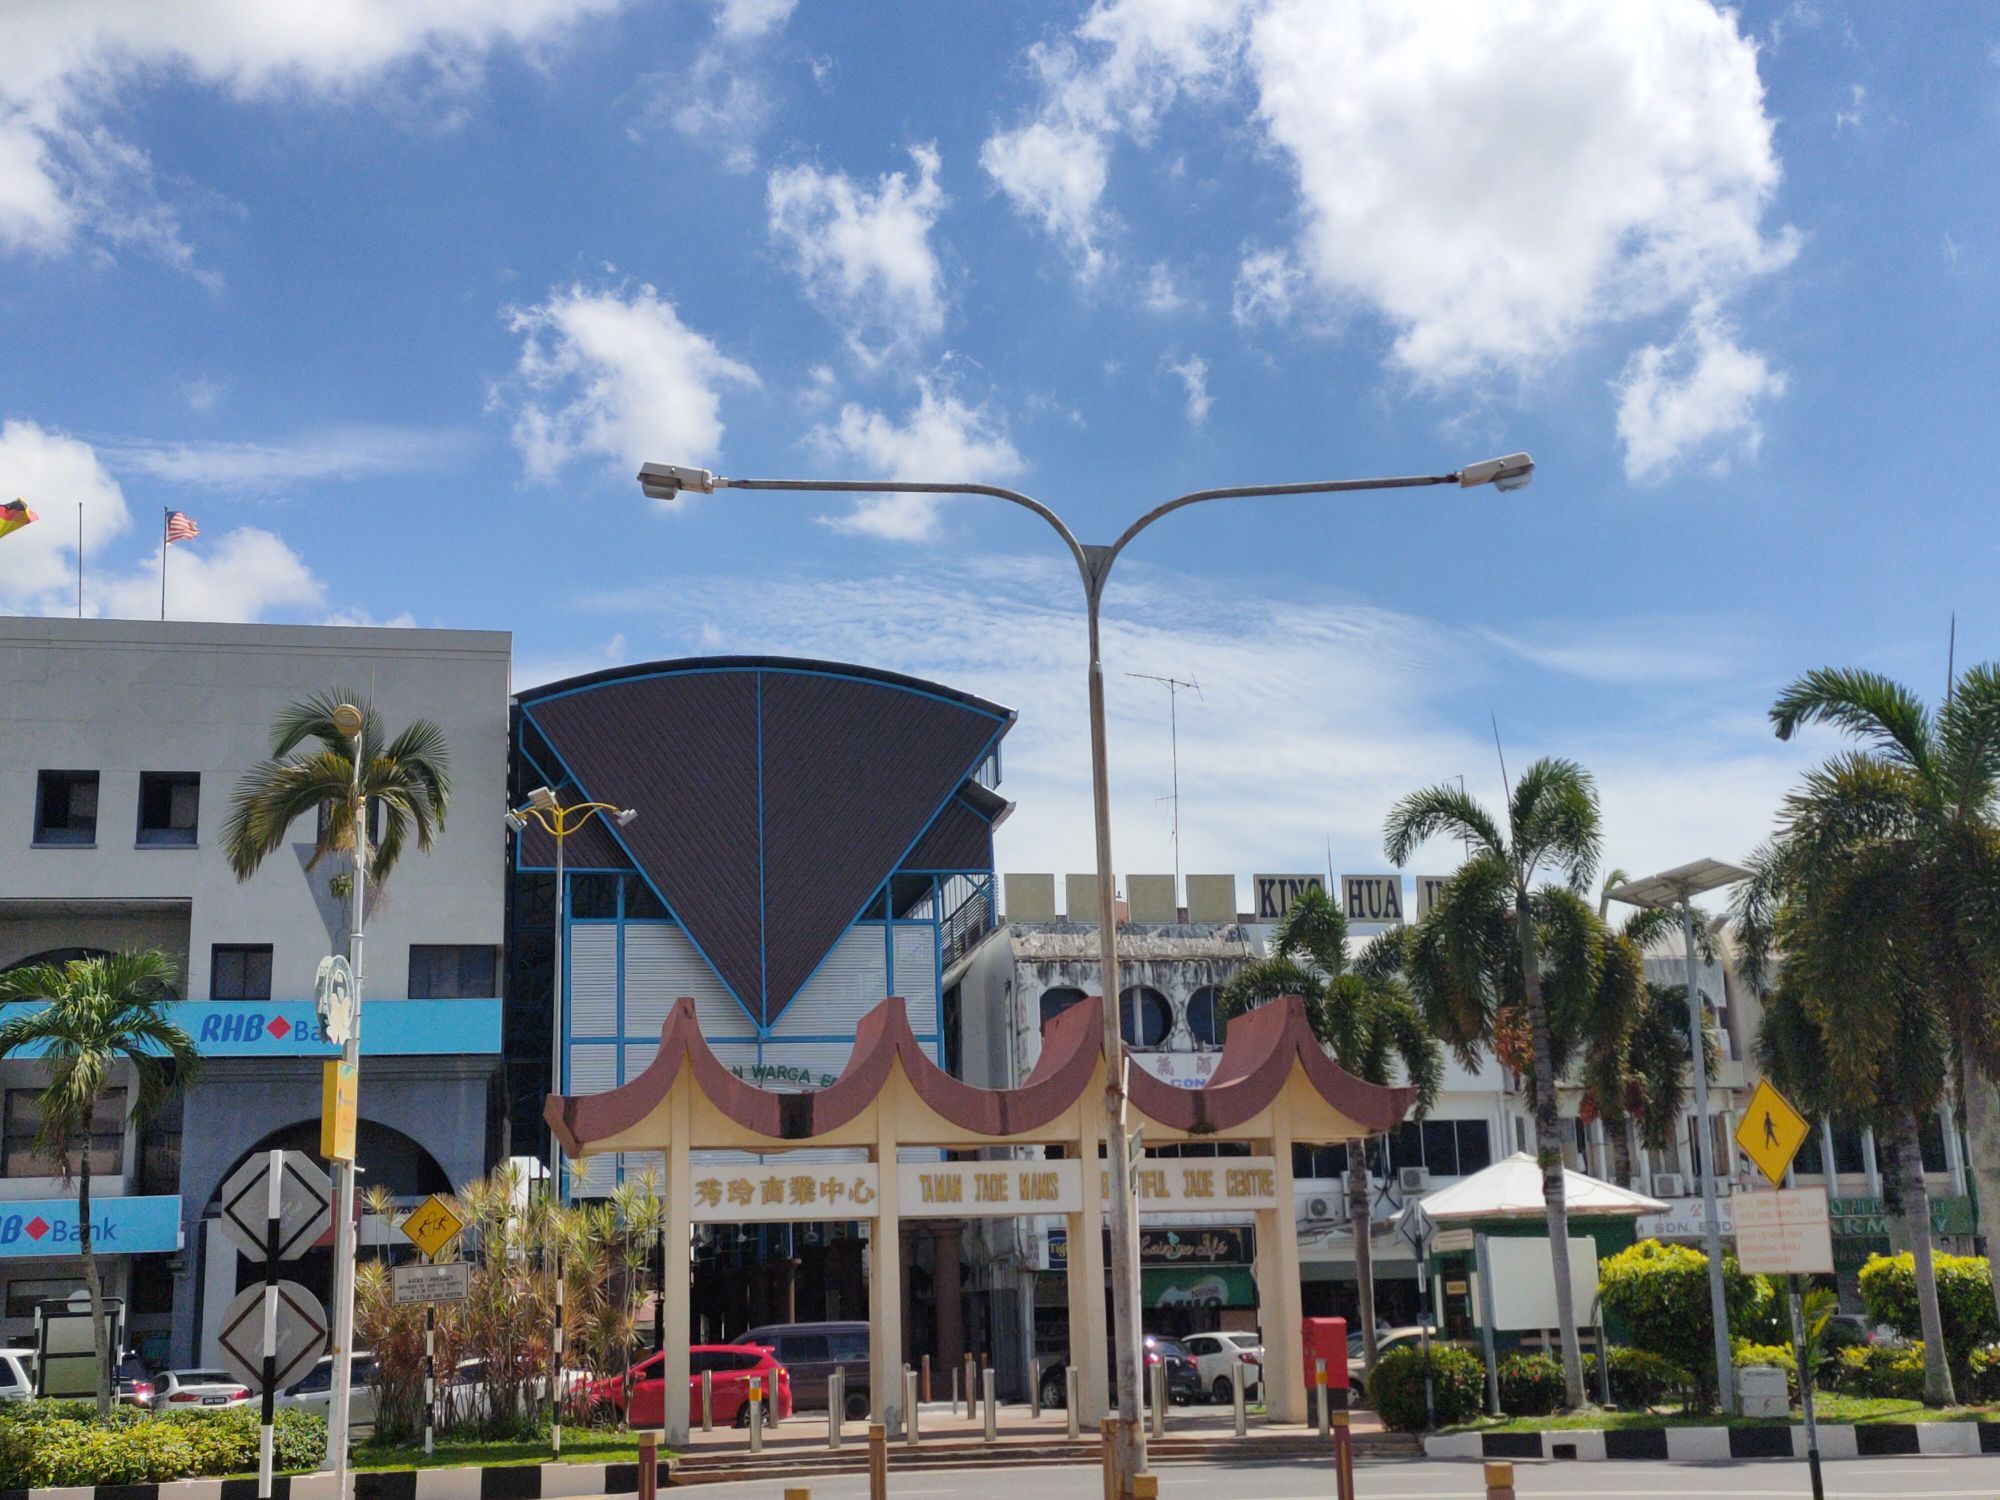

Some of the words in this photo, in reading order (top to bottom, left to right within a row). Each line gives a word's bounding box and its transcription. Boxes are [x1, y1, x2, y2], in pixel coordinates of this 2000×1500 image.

[1350, 879, 1402, 919] HUA
[200, 1013, 265, 1042] RHB
[294, 1020, 321, 1042] Ba
[752, 1063, 811, 1083] WARGA
[919, 1173, 962, 1203] TAMAN
[974, 1172, 1008, 1202] JADE
[1019, 1171, 1059, 1201] MANIS
[1183, 1169, 1214, 1198] JADE
[1225, 1168, 1276, 1198] CENTRE
[53, 1216, 118, 1242] Bank
